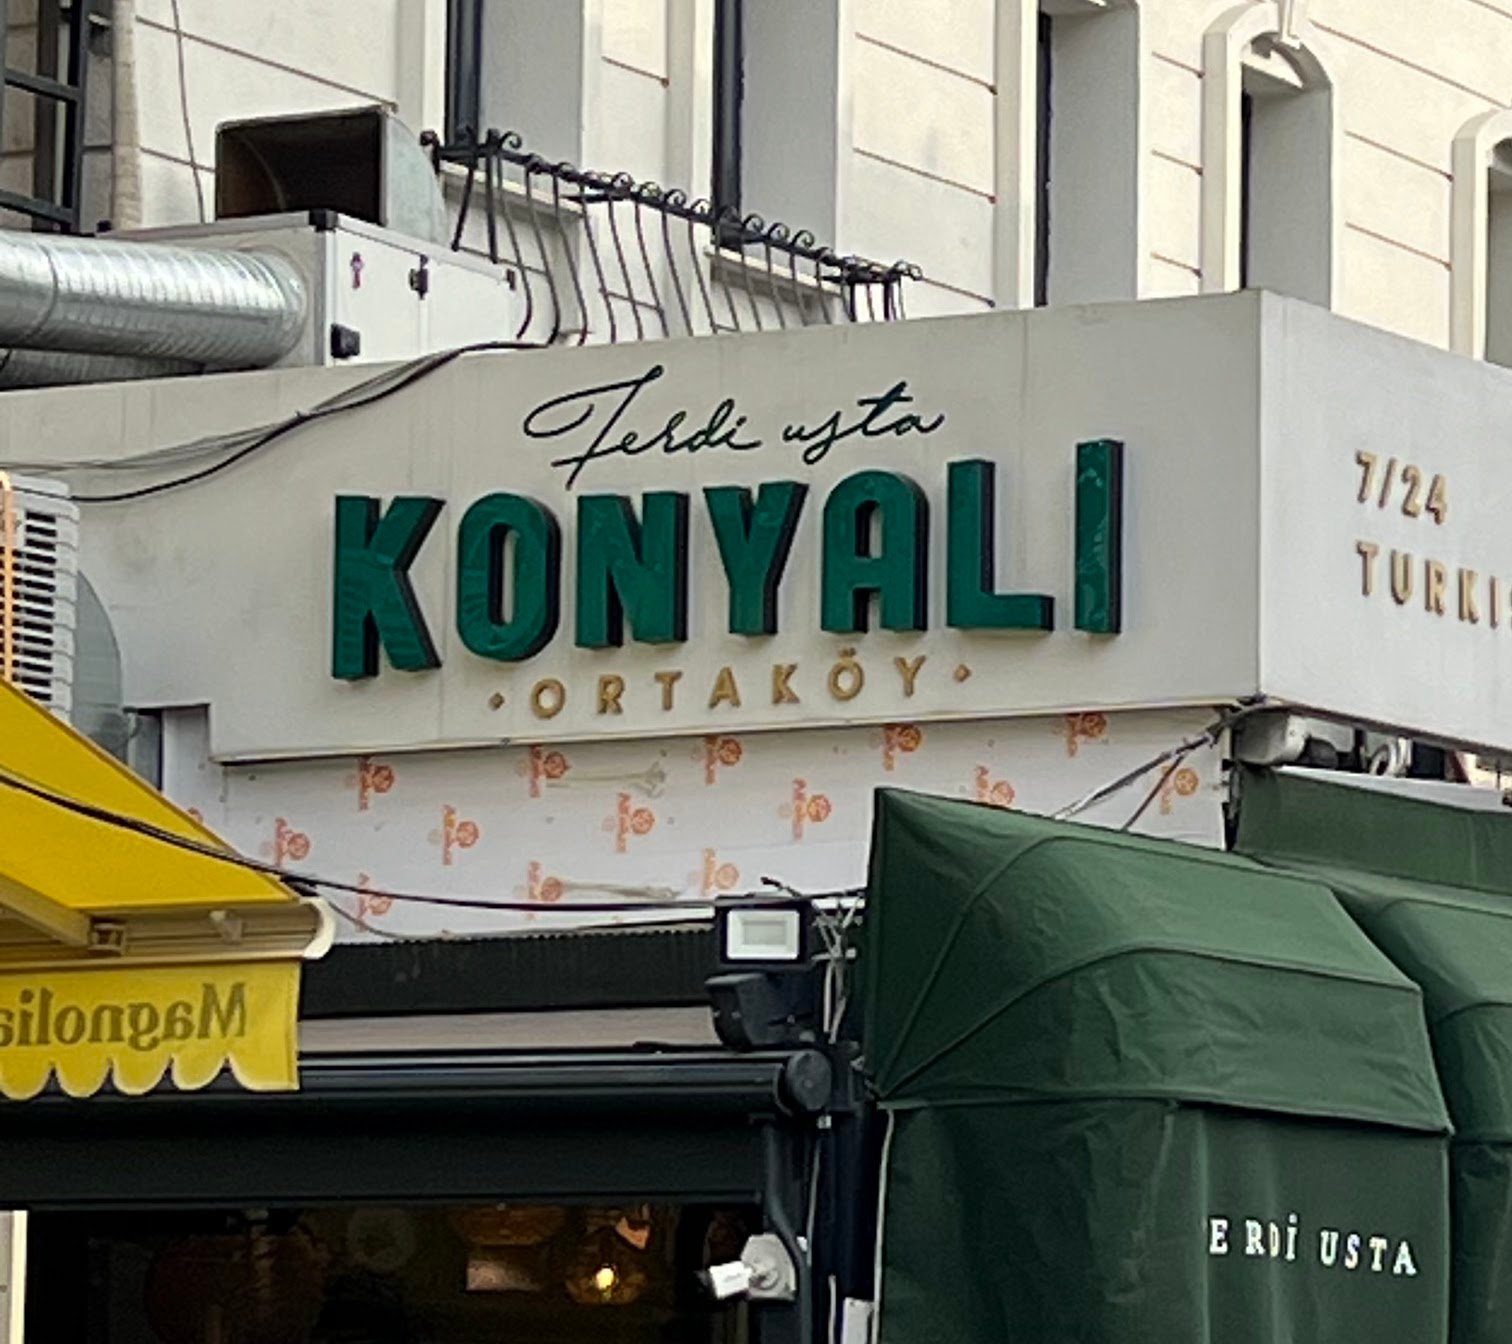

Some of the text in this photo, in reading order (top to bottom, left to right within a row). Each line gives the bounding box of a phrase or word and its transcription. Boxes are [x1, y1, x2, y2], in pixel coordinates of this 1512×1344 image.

[782, 380, 946, 464] usta
[1355, 449, 1449, 525] 7/24
[331, 439, 1126, 683] KONYALI
[528, 647, 929, 720] ORTAKÖY
[1319, 1229, 1418, 1275] USTA
